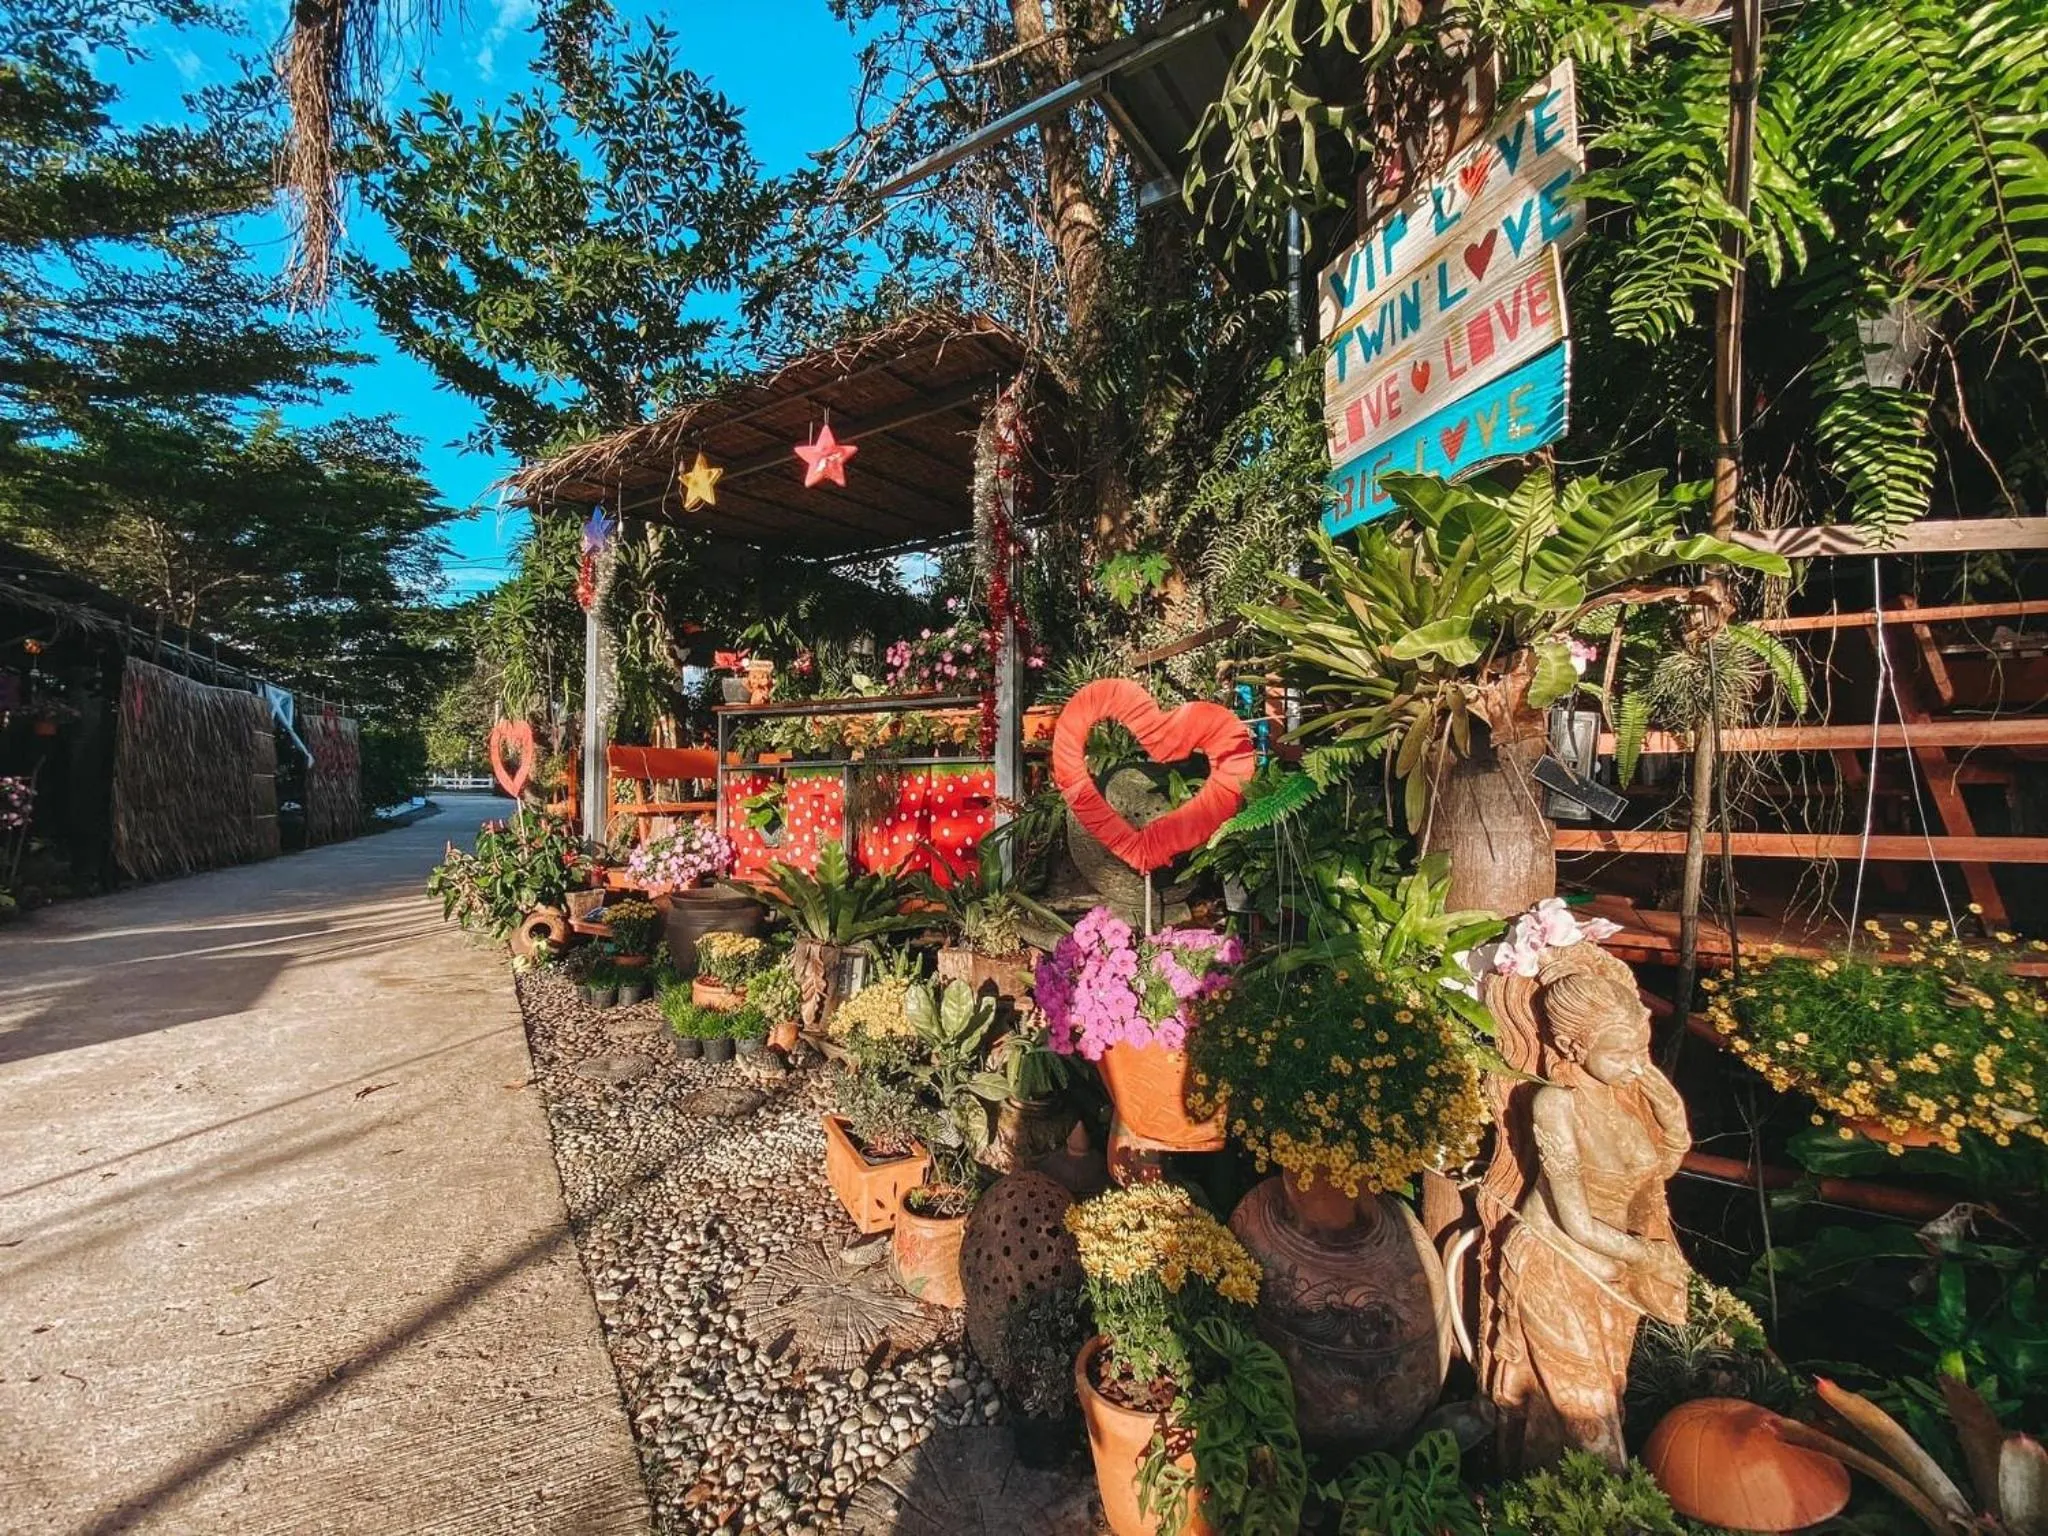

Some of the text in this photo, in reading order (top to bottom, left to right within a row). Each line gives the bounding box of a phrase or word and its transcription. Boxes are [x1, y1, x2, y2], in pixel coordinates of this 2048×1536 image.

[1330, 210, 1408, 308] VIP
[1334, 280, 1421, 384] TWIN
[1444, 270, 1552, 382] LOVE
